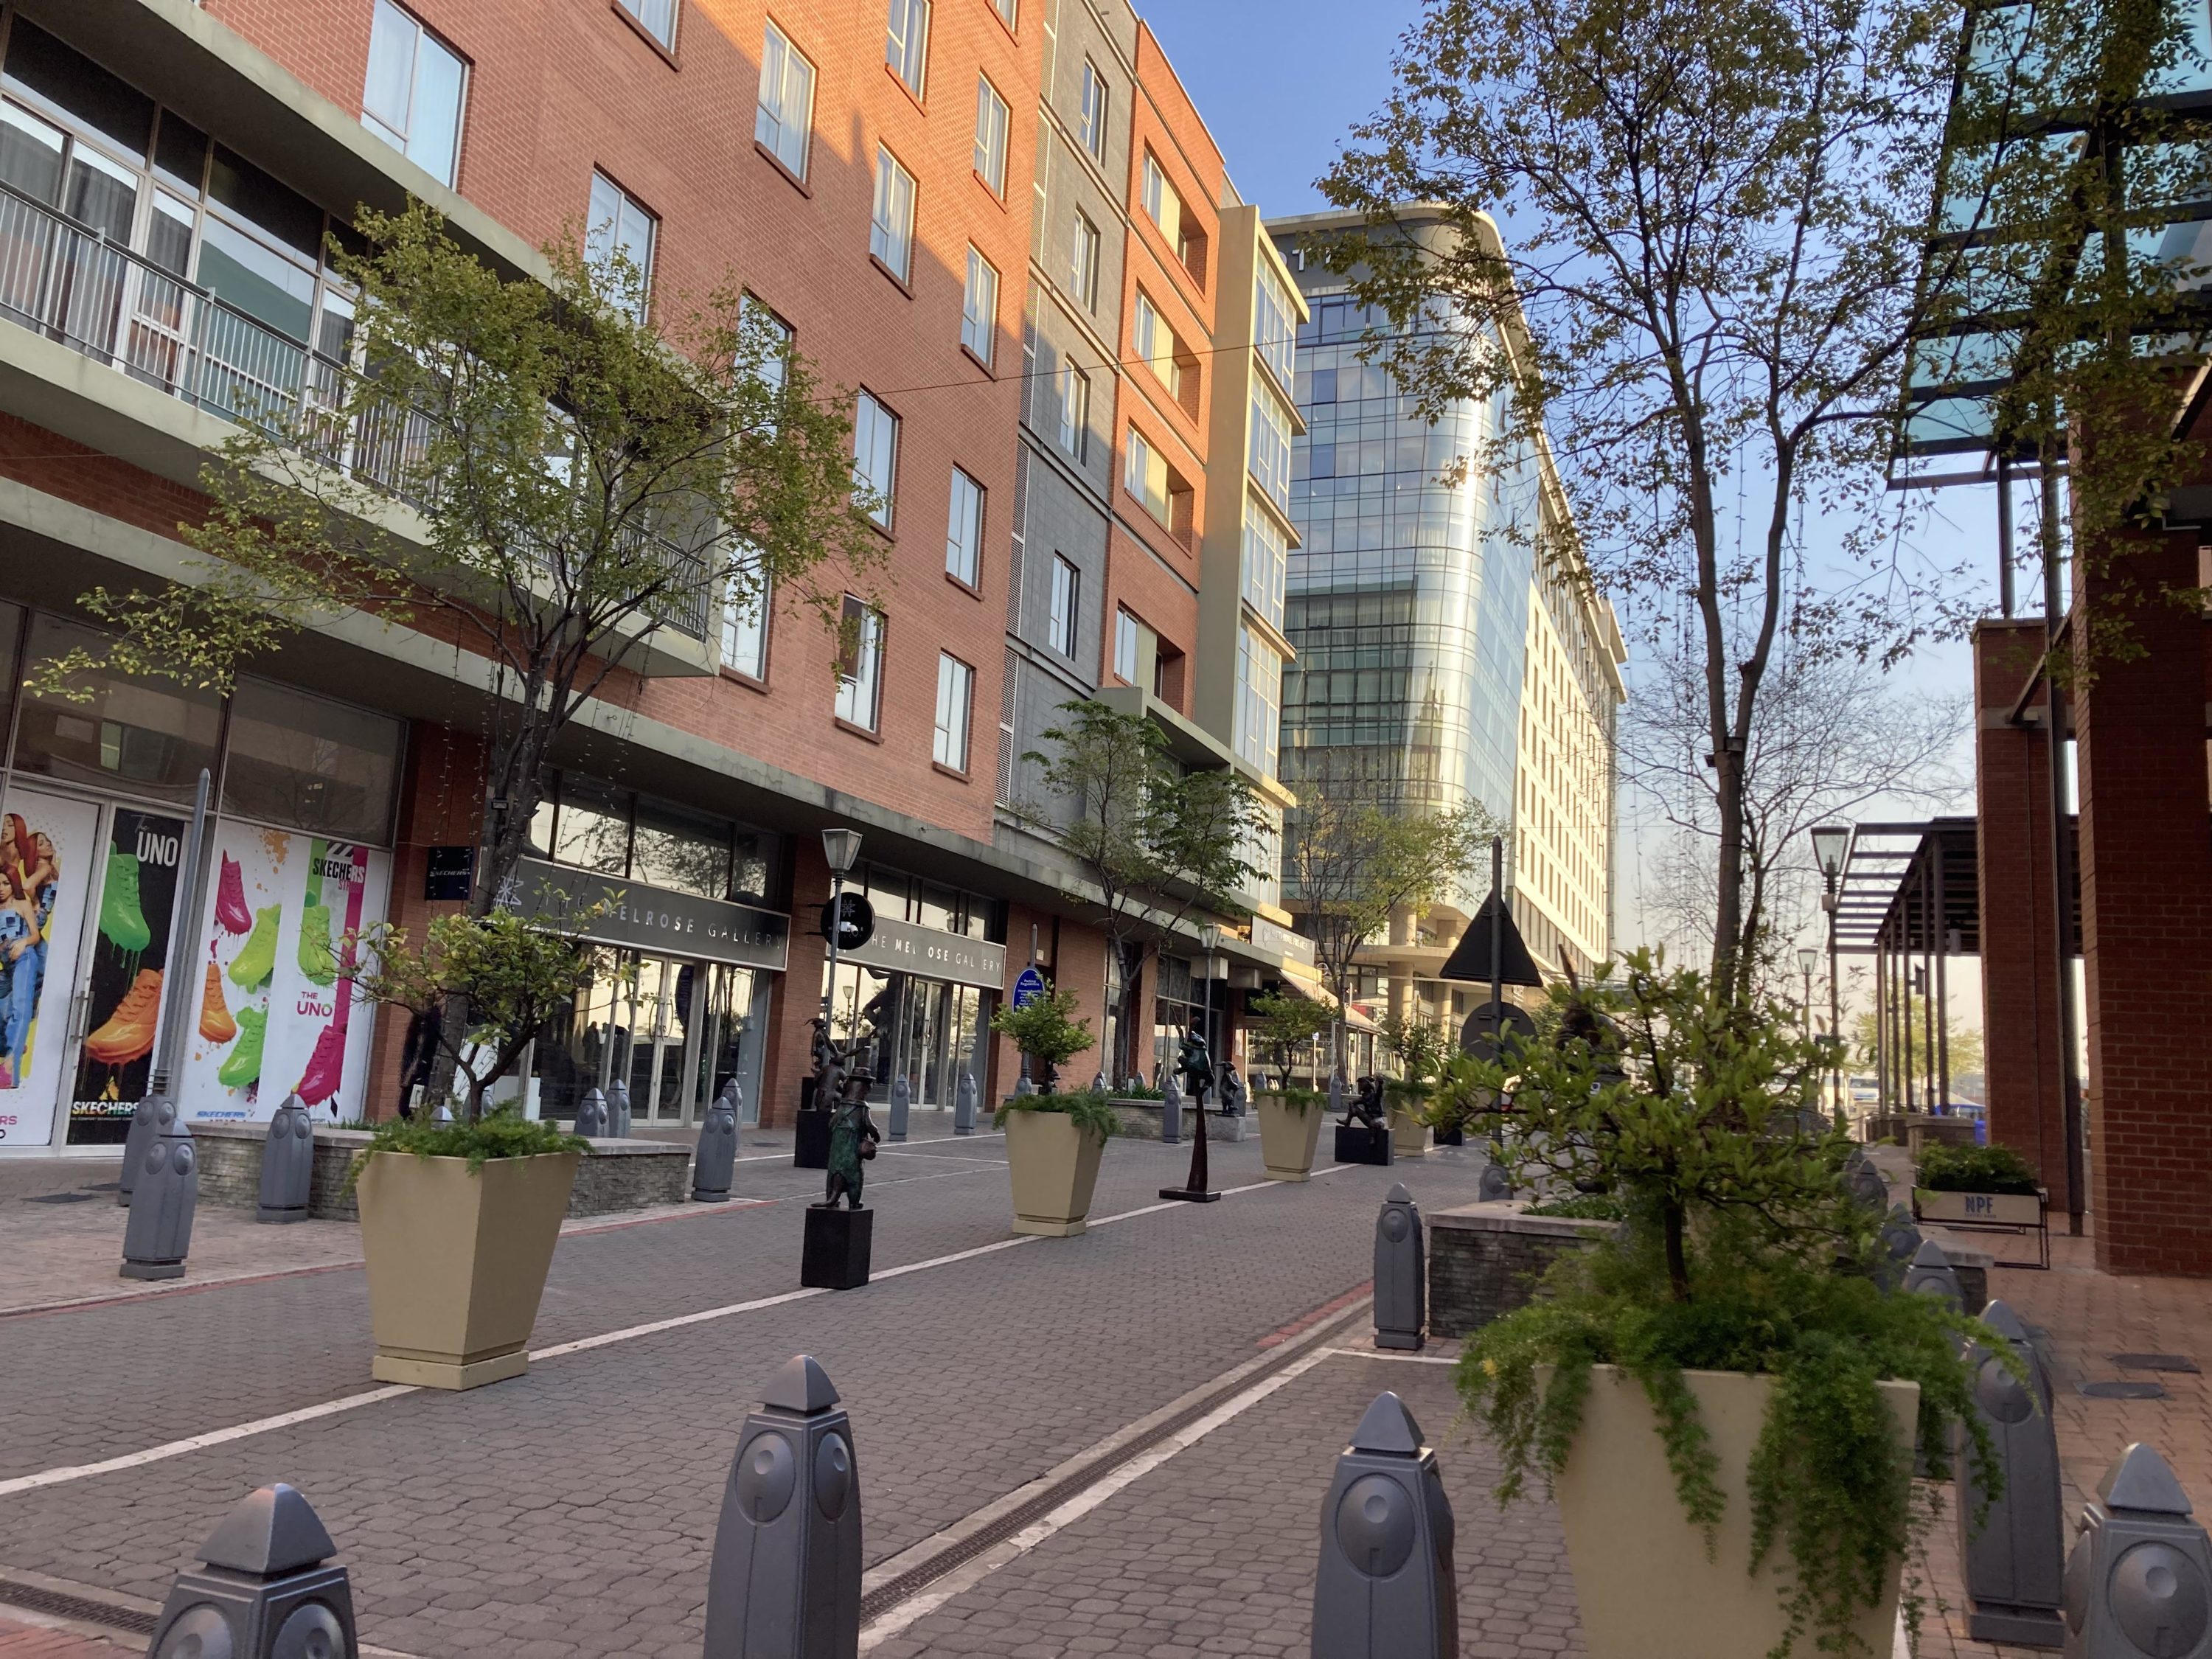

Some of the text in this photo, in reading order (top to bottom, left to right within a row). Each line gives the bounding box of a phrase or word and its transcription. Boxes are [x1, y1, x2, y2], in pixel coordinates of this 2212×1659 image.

[136, 831, 178, 867] UNO
[313, 858, 365, 884] SKECHERS
[708, 922, 785, 950] GALLERY
[872, 934, 1001, 973] HE MELOSE GALERY
[301, 991, 319, 1000] THE
[296, 1001, 333, 1018] UNO
[1964, 1196, 1994, 1214] NPF
